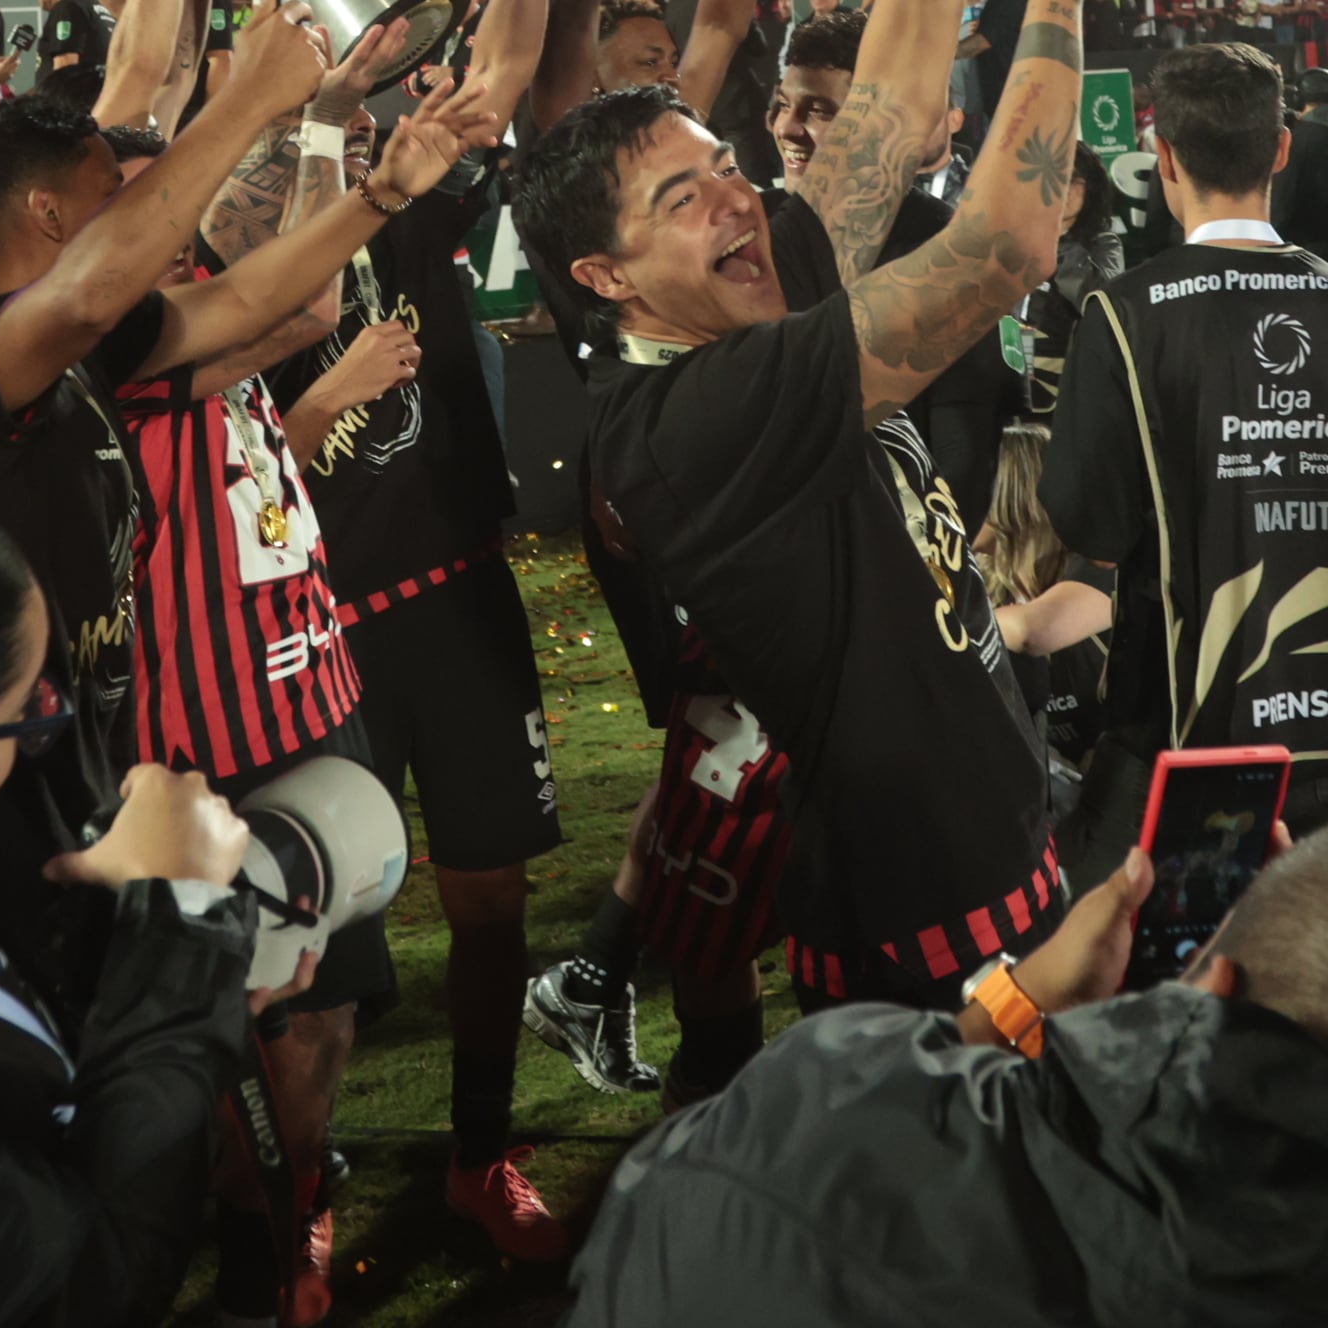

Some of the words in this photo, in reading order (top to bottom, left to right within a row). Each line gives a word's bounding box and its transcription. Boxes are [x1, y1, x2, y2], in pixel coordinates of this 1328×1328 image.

[1149, 274, 1221, 304] Banco
[1258, 384, 1311, 415] Liga
[240, 1077, 281, 1166] Canon
